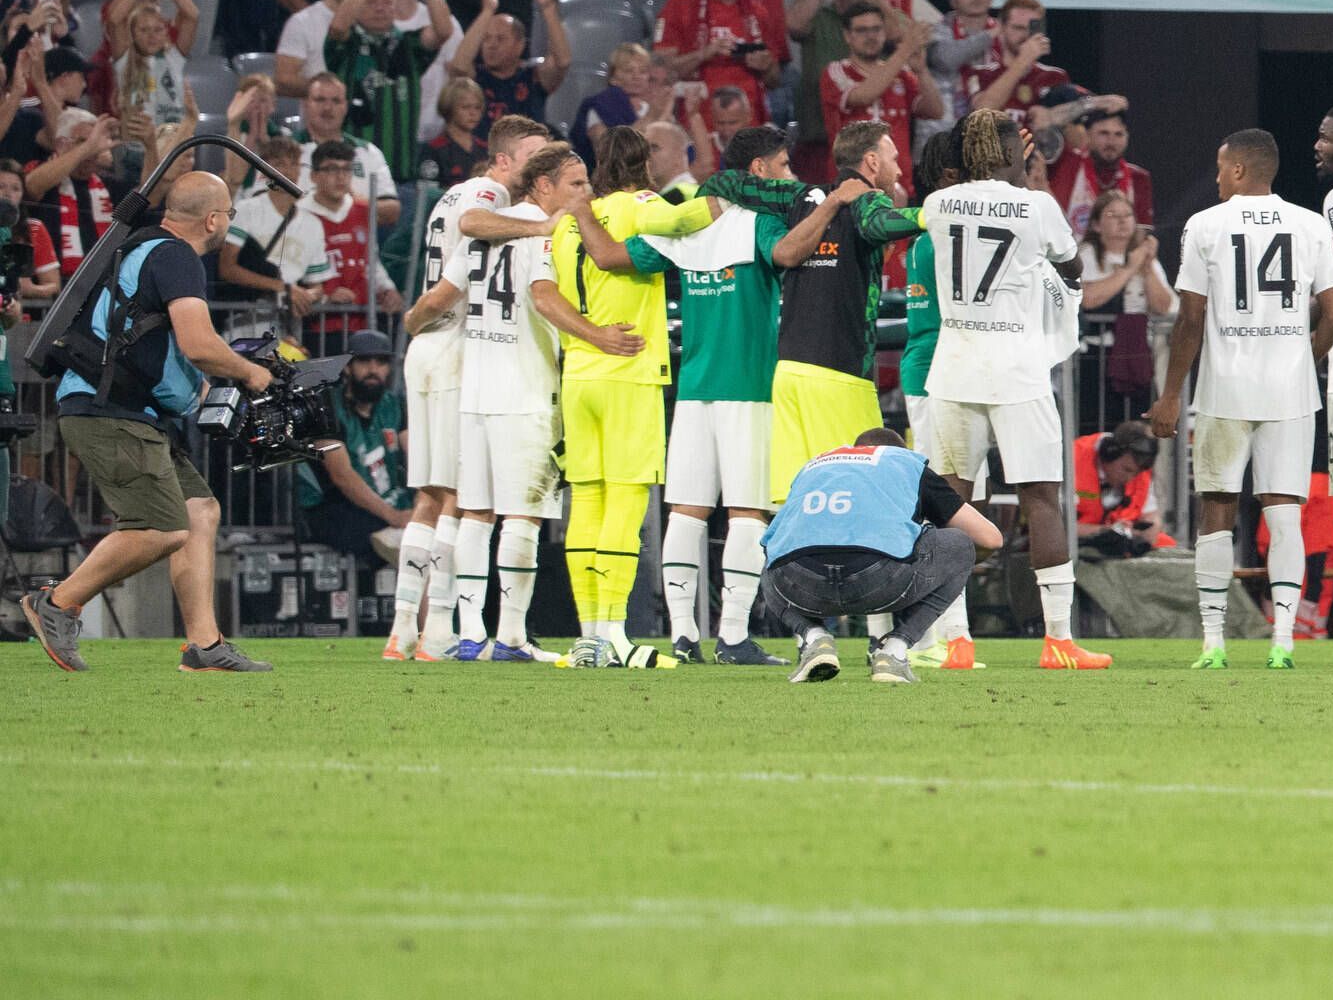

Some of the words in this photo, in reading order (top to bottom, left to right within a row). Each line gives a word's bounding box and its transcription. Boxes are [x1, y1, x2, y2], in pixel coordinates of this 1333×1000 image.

[939, 199, 984, 217] MANU
[988, 202, 1031, 219] KONE
[1241, 210, 1283, 225] PLEA
[468, 239, 517, 322] 24
[949, 223, 1019, 306] 17
[1231, 232, 1298, 312] 14
[802, 490, 853, 515] 06
